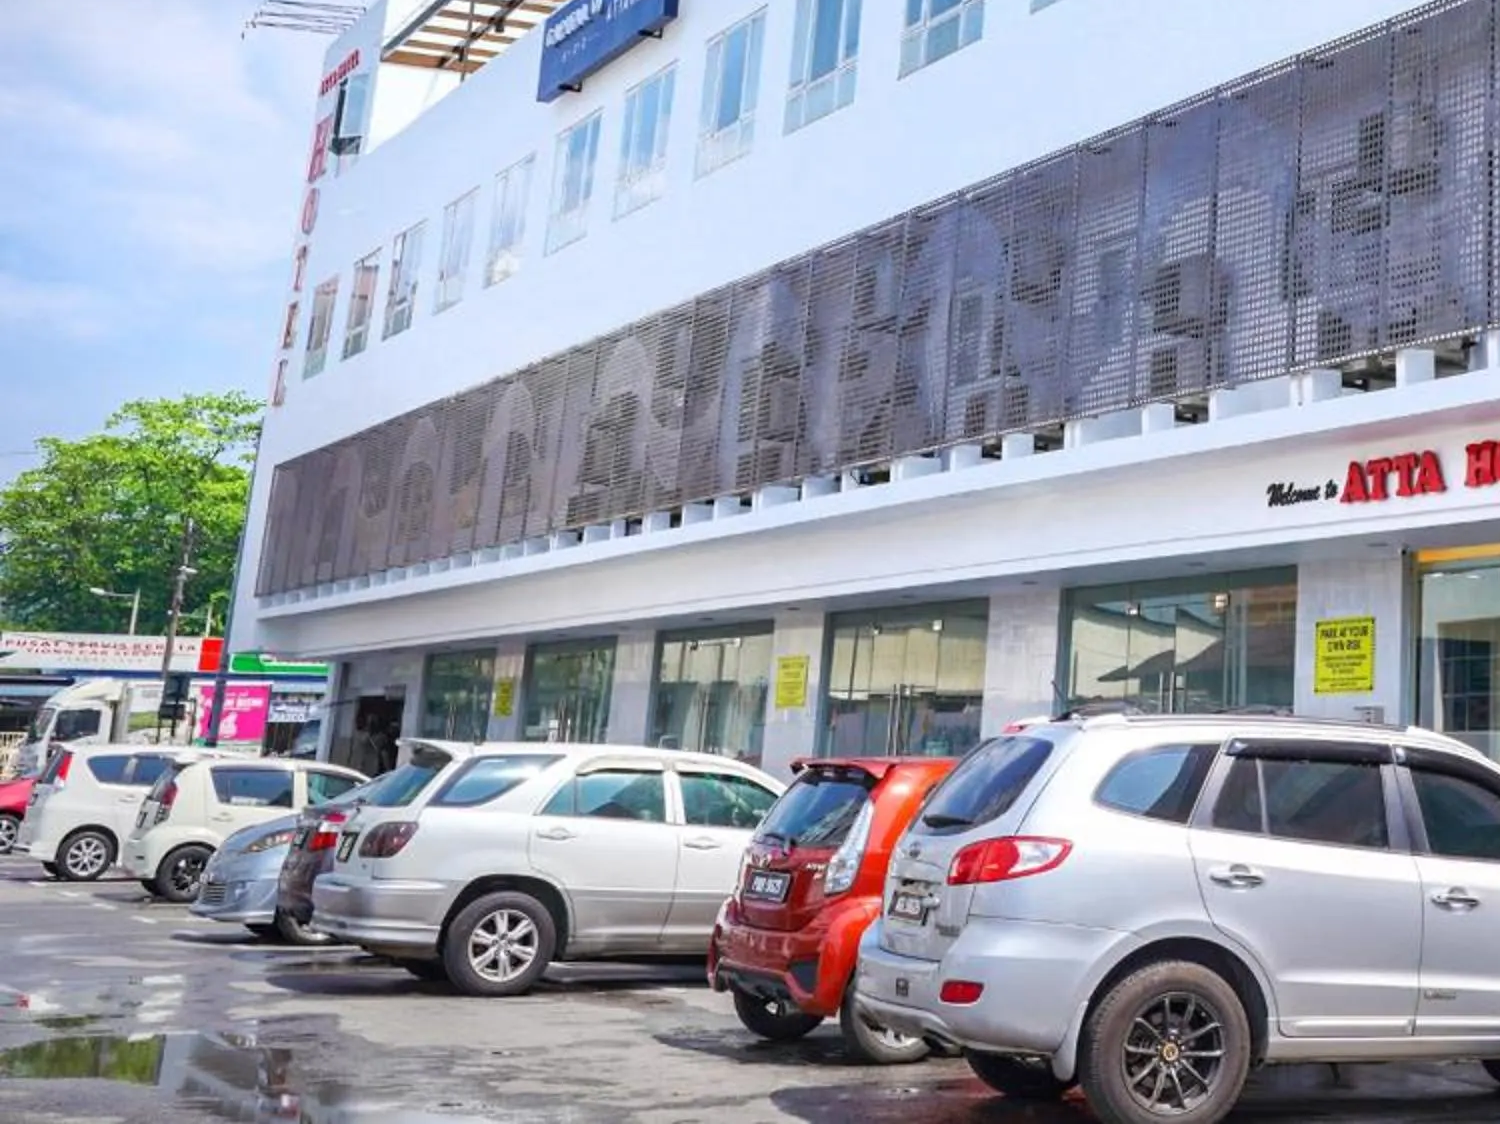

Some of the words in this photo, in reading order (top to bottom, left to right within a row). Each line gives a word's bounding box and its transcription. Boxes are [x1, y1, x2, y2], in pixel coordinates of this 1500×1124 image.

[1266, 481, 1321, 507] Welcome
[1324, 478, 1338, 501] to
[1340, 449, 1448, 504] ATTA
[132, 642, 197, 651] KERTA
